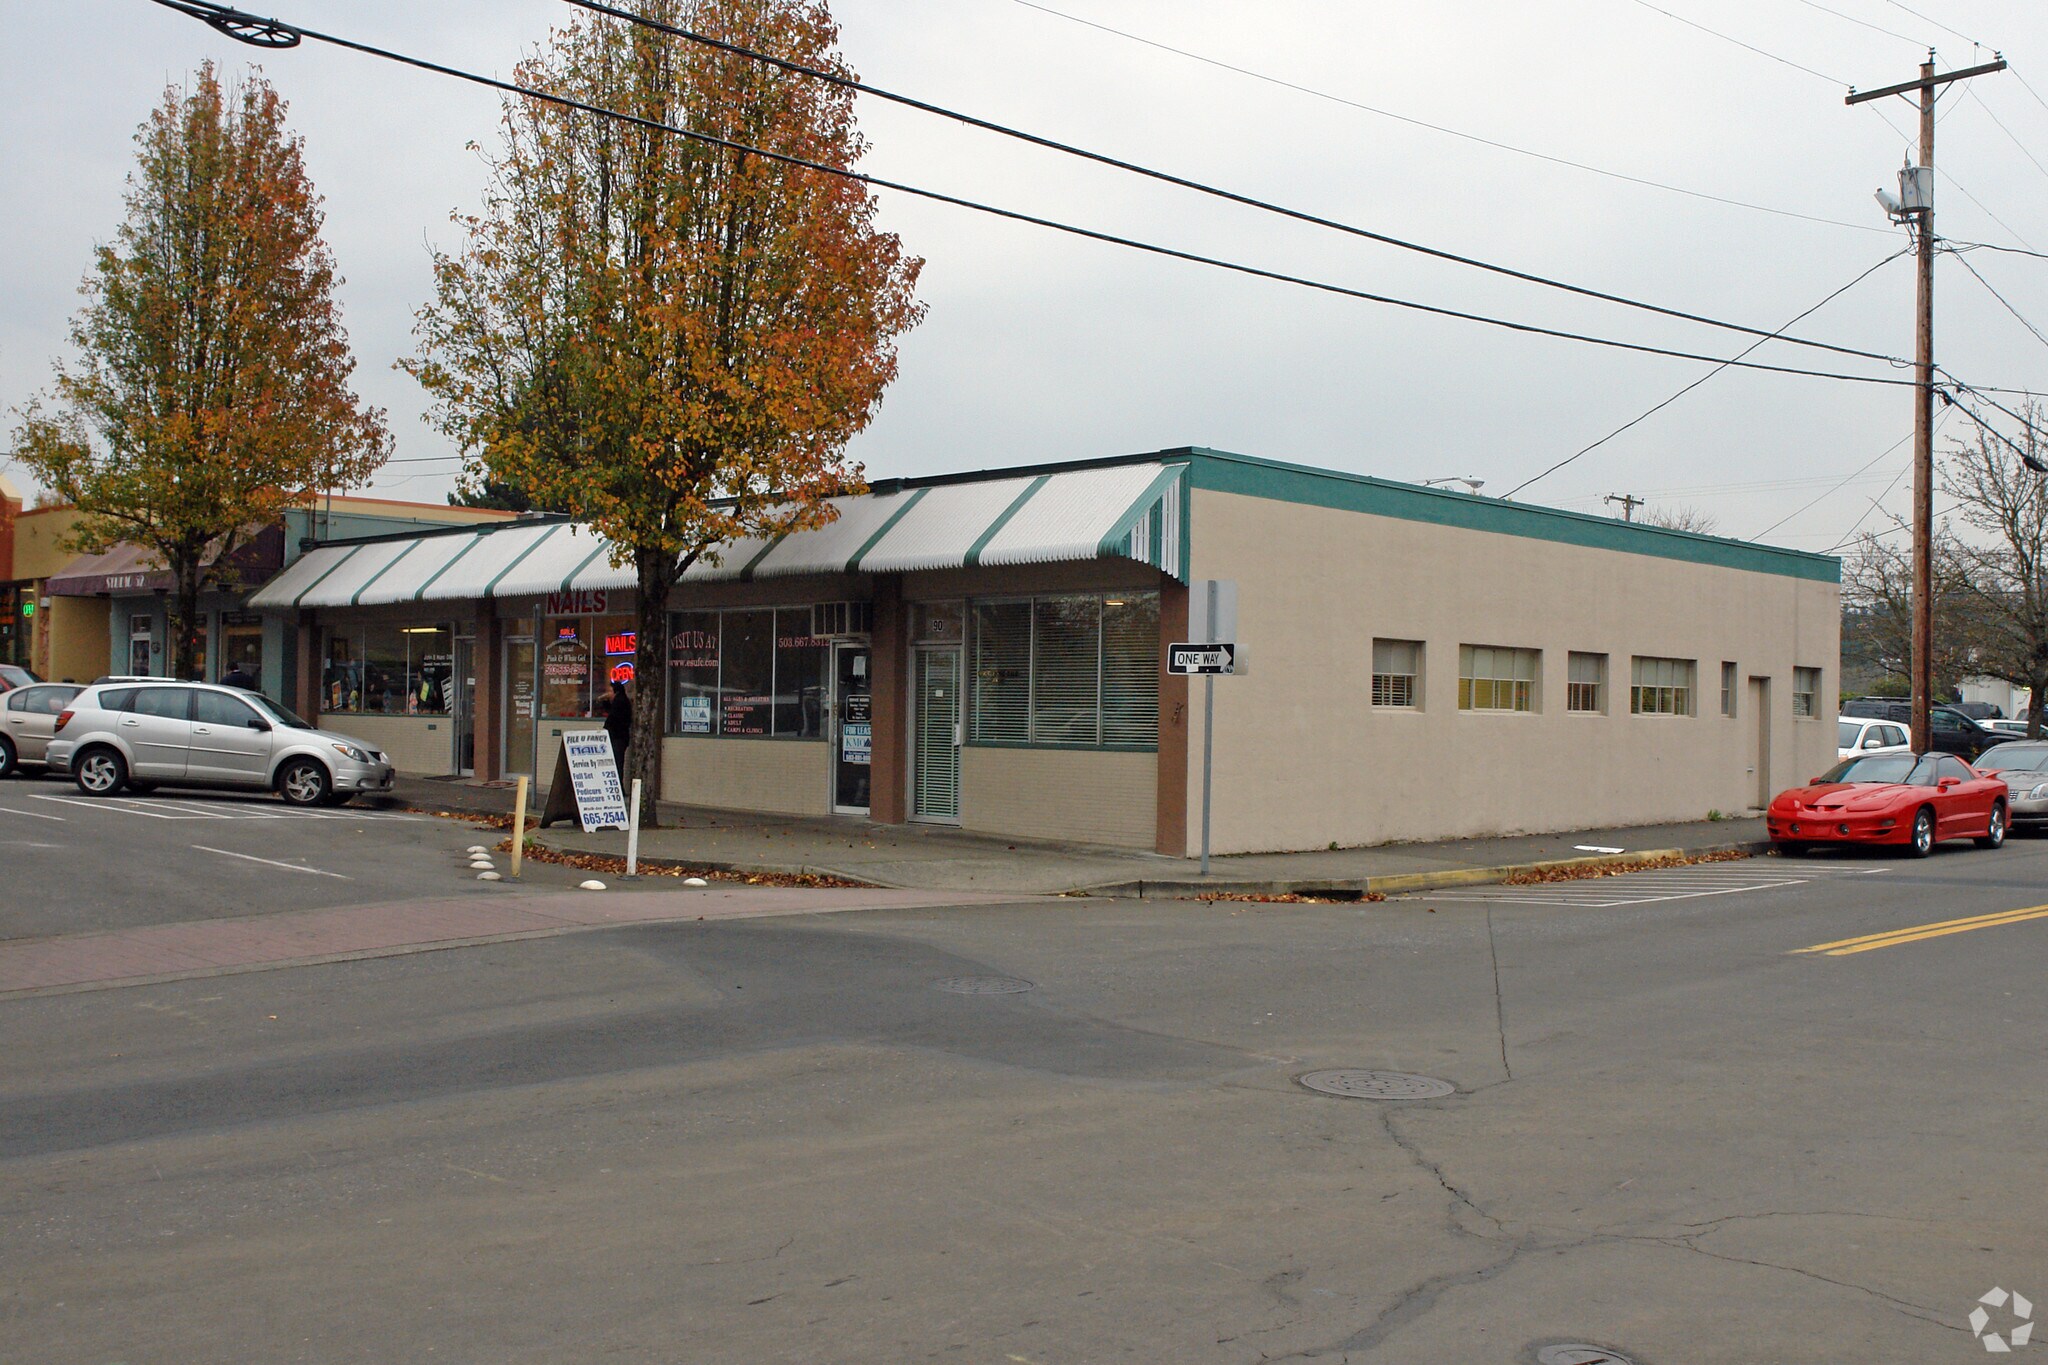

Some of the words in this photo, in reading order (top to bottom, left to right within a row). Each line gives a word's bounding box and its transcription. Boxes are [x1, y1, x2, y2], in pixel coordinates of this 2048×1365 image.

[547, 590, 606, 614] NAILS
[933, 620, 943, 631] 90
[606, 635, 636, 653] NAILS
[670, 631, 691, 649] VISIT
[693, 630, 704, 649] US
[705, 635, 717, 649] AT
[1177, 653, 1200, 665] ONE
[1203, 652, 1220, 665] WAY
[610, 667, 635, 681] OPEN
[845, 726, 857, 736] FOR
[857, 726, 871, 736] LEAS
[566, 735, 580, 744] FILE
[587, 734, 607, 742] FANCY
[572, 760, 590, 768] Service
[590, 759, 597, 769] By
[572, 772, 584, 780] Full
[584, 772, 594, 780] Set
[583, 811, 626, 825] 665-2544
